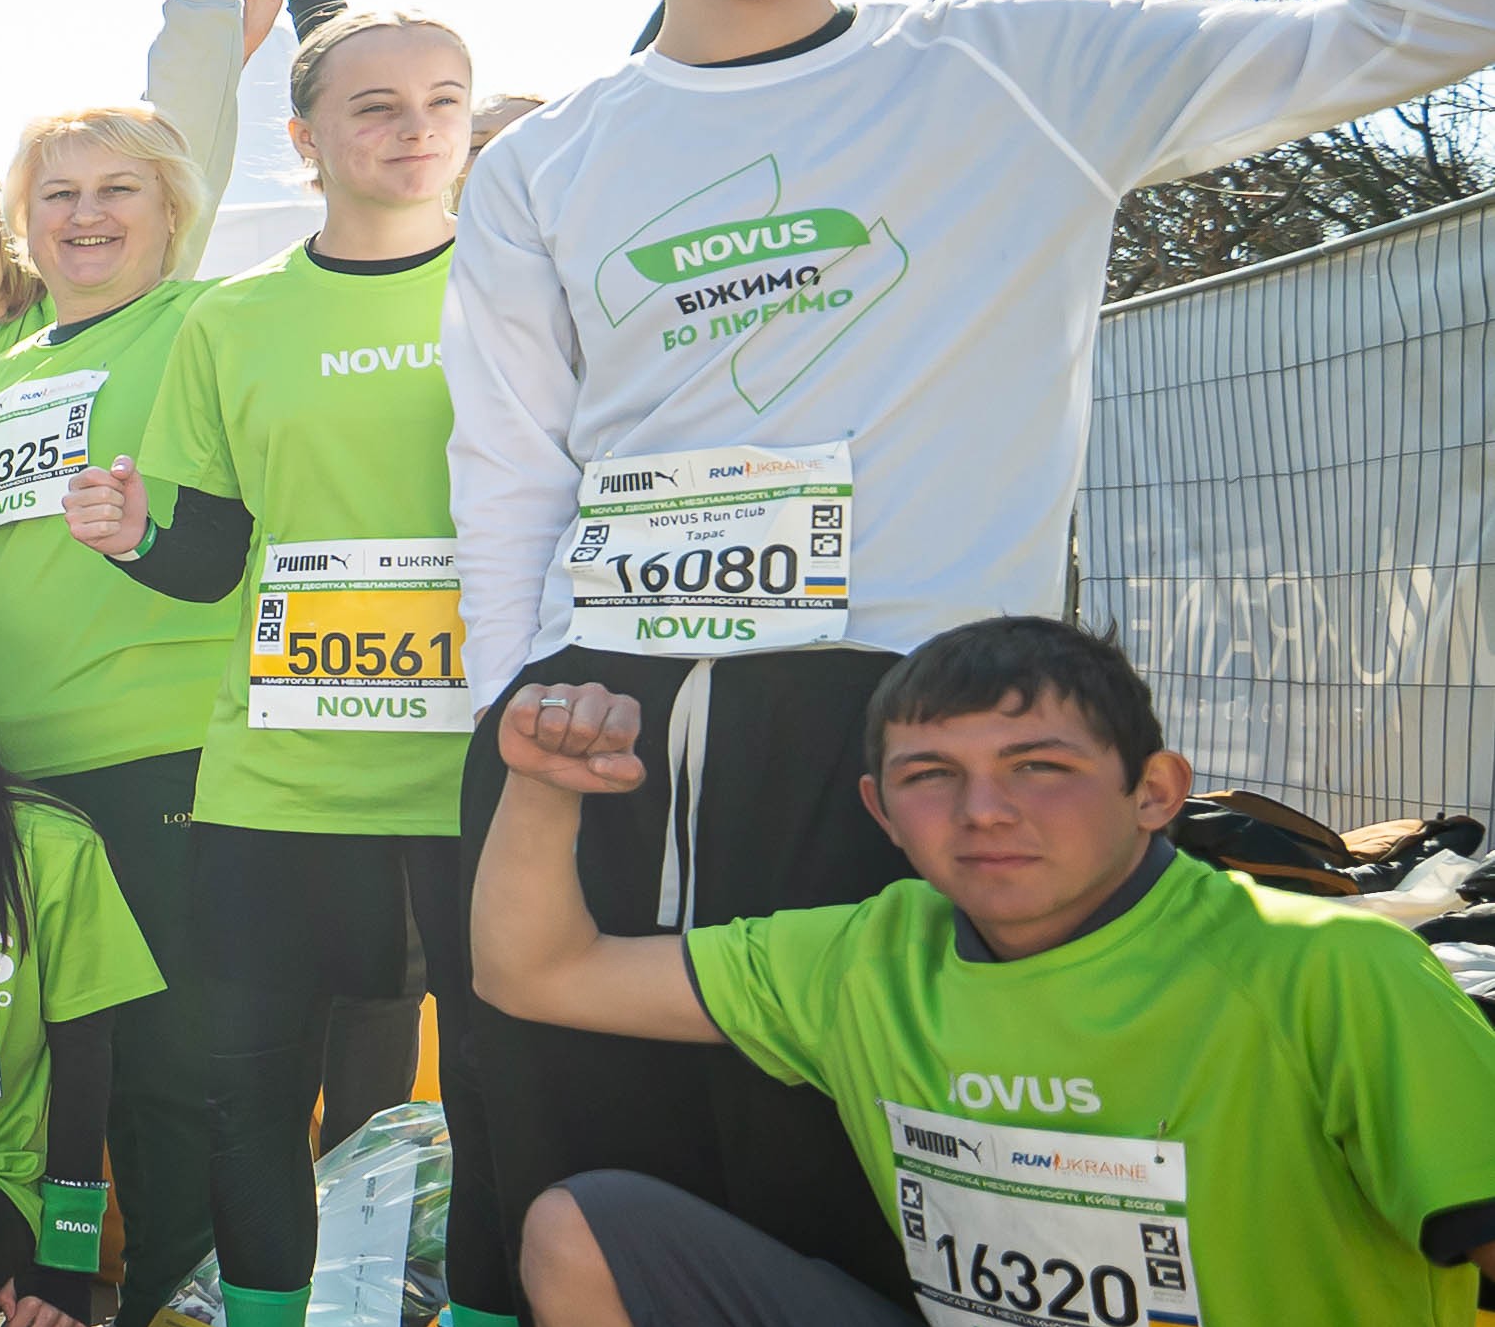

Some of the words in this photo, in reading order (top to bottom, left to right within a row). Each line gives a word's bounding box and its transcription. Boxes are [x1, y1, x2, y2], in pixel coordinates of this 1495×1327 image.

[673, 219, 818, 272] NOVUS
[674, 266, 821, 315] БІЖИМО
[663, 325, 697, 352] БО
[20, 391, 44, 401] RUN
[709, 465, 744, 478] RUN
[600, 472, 654, 494] PUMA
[649, 512, 699, 528] NOVUS
[703, 510, 731, 523] Run
[735, 507, 766, 519] Club
[686, 529, 725, 542] Тарас
[276, 555, 328, 572] PUMA
[606, 543, 798, 595] 16080
[268, 582, 300, 591] NOVUS
[797, 599, 834, 608] ЕТАП
[636, 616, 756, 641] NOVUS
[288, 632, 452, 677] 50561
[262, 677, 316, 686] НАФТОГАЗ
[341, 678, 420, 687] НЕЗЛАМНОСТІ
[316, 696, 427, 718] NOVUS
[904, 1125, 959, 1158] PUMA
[1011, 1151, 1051, 1168] RUN
[55, 1218, 98, 1234] NOVUS
[936, 1233, 1139, 1327] 16320
